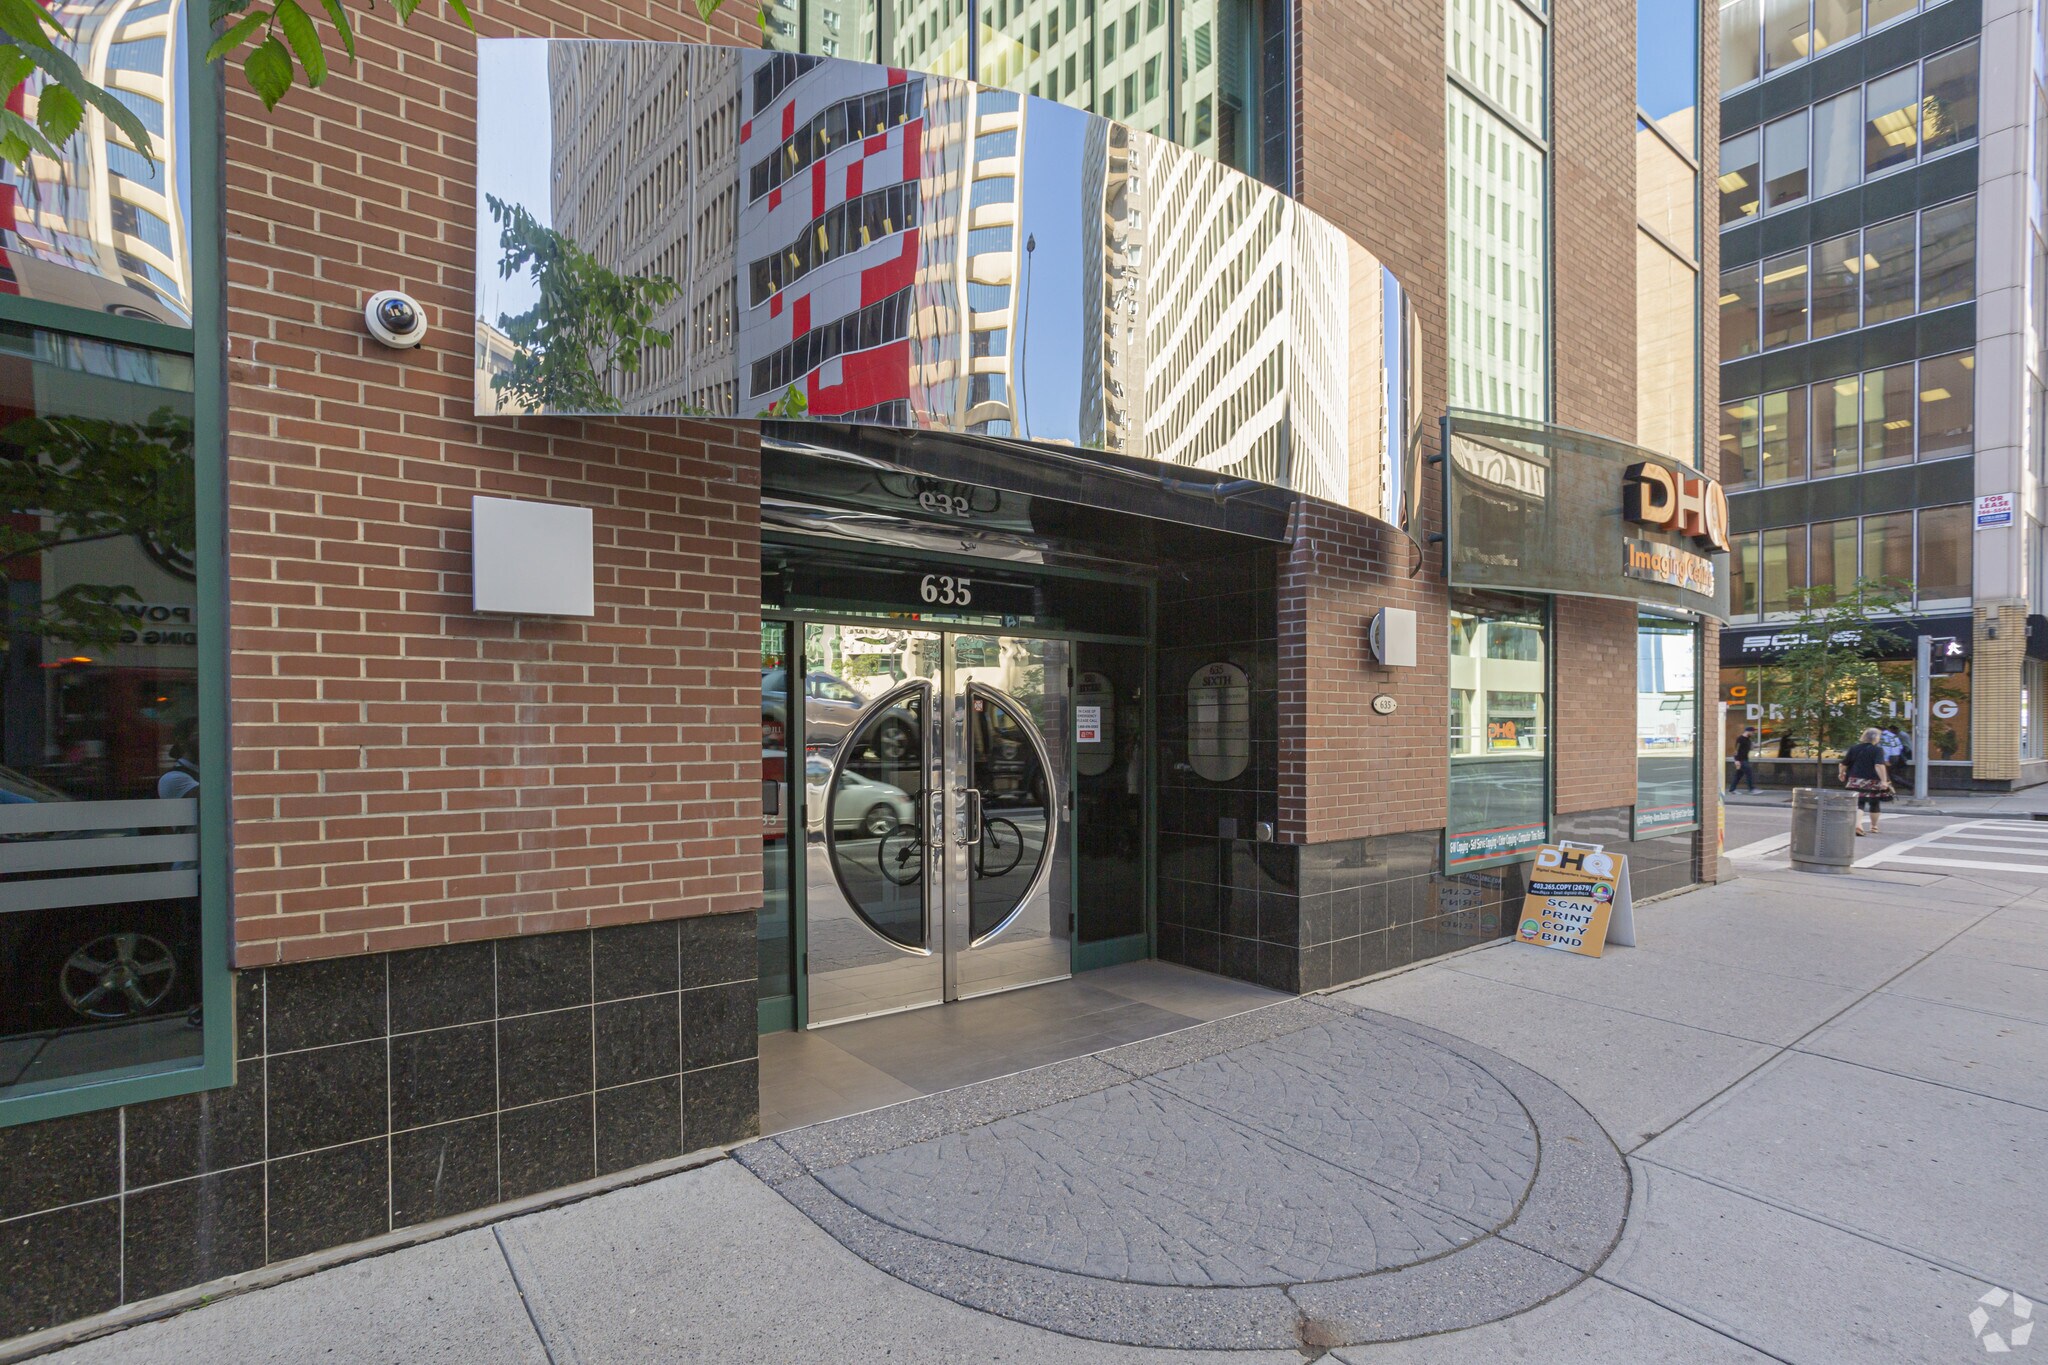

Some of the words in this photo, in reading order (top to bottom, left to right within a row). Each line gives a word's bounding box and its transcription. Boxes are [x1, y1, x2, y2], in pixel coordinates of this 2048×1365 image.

[1623, 462, 1730, 552] DHQ
[1979, 501, 2010, 509] LEASE
[1629, 543, 1686, 585] Imaging
[920, 574, 972, 606] 635
[1202, 676, 1231, 686] SIXTH
[1379, 700, 1391, 710] 635
[1488, 720, 1516, 739] DHQ
[1537, 849, 1614, 878] DHQ
[1532, 883, 1572, 891] 403.265.COPY
[1572, 883, 1592, 892] (2679)
[1547, 898, 1593, 912] SCAN
[1542, 909, 1594, 924] PRINT
[1541, 921, 1588, 935] COPY
[1541, 932, 1582, 947] BIND
